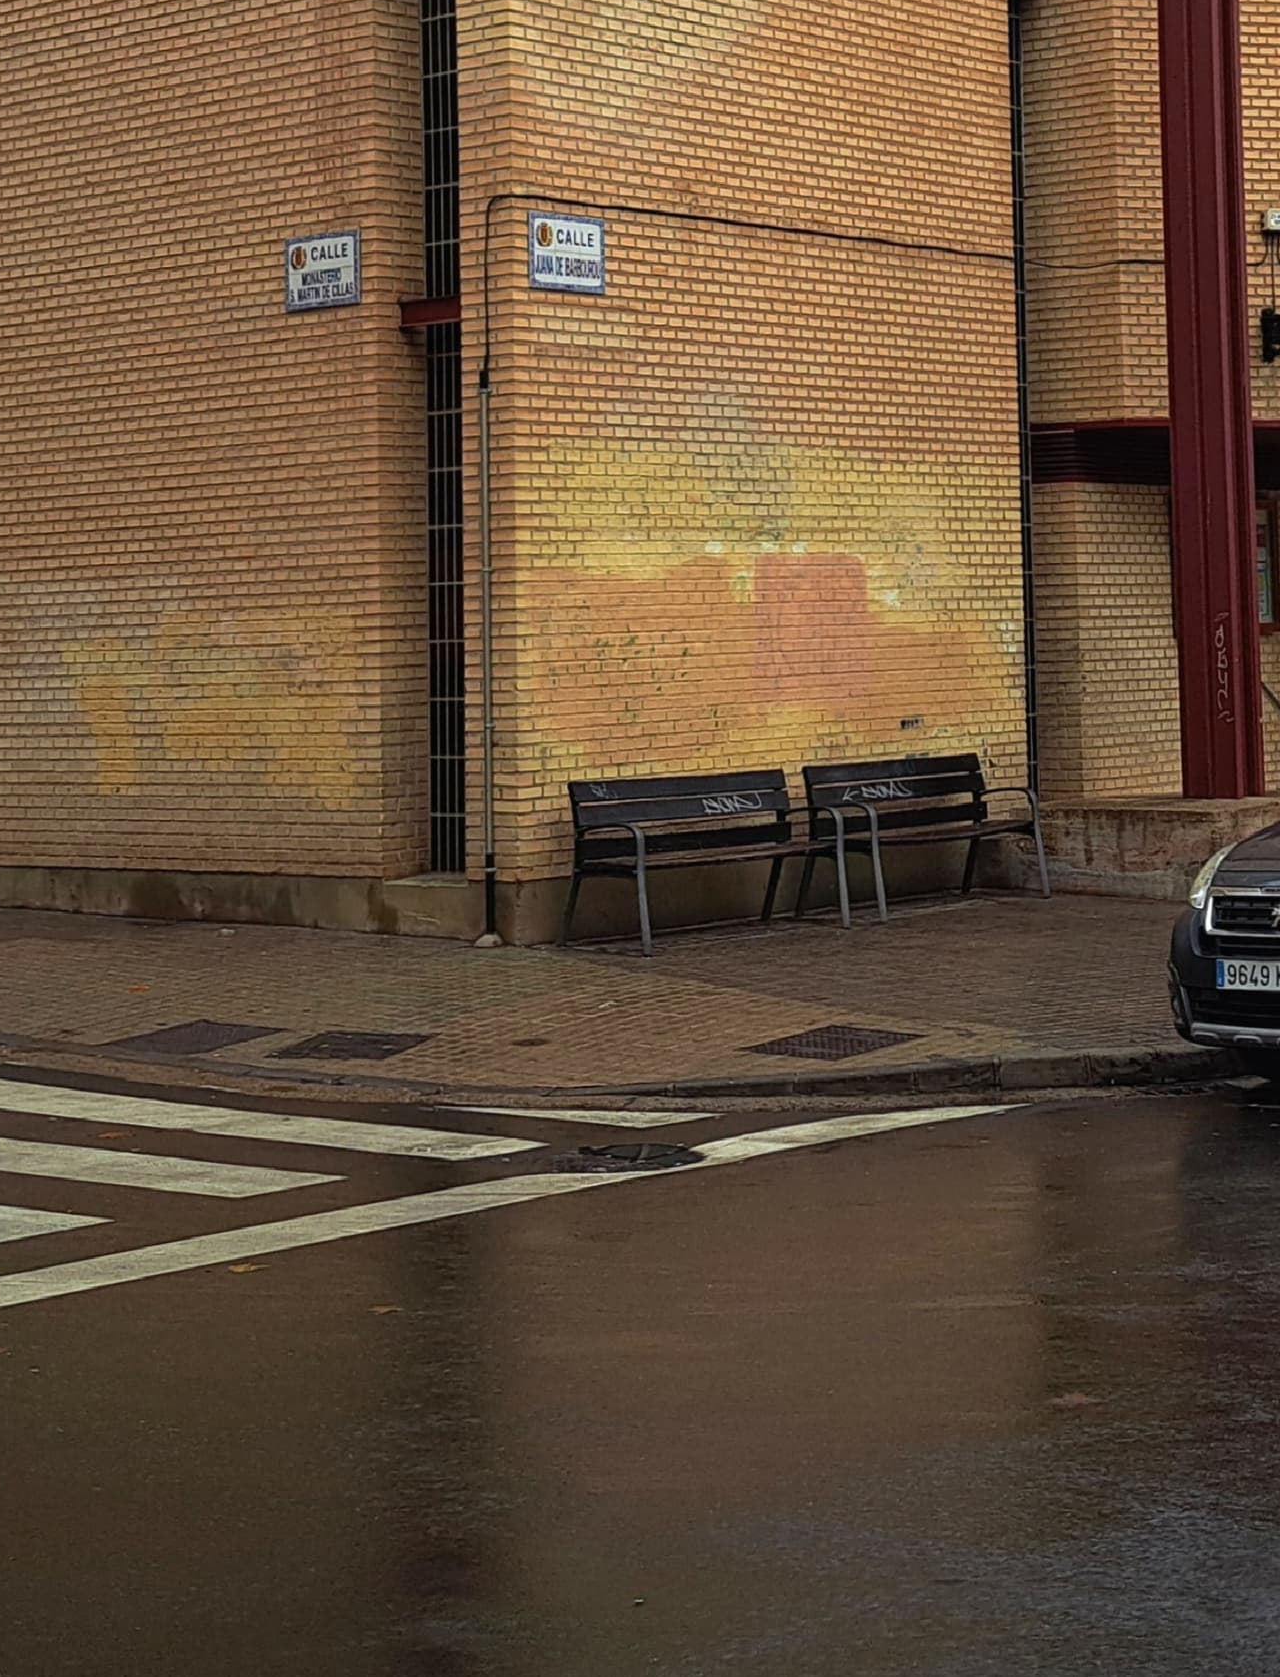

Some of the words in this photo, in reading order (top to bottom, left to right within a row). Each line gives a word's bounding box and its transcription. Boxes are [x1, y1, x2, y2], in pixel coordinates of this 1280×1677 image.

[556, 229, 594, 247] CALLE
[311, 243, 348, 261] CALLE
[555, 256, 564, 276] DE
[322, 284, 330, 298] DE
[1227, 964, 1270, 986] 9649
